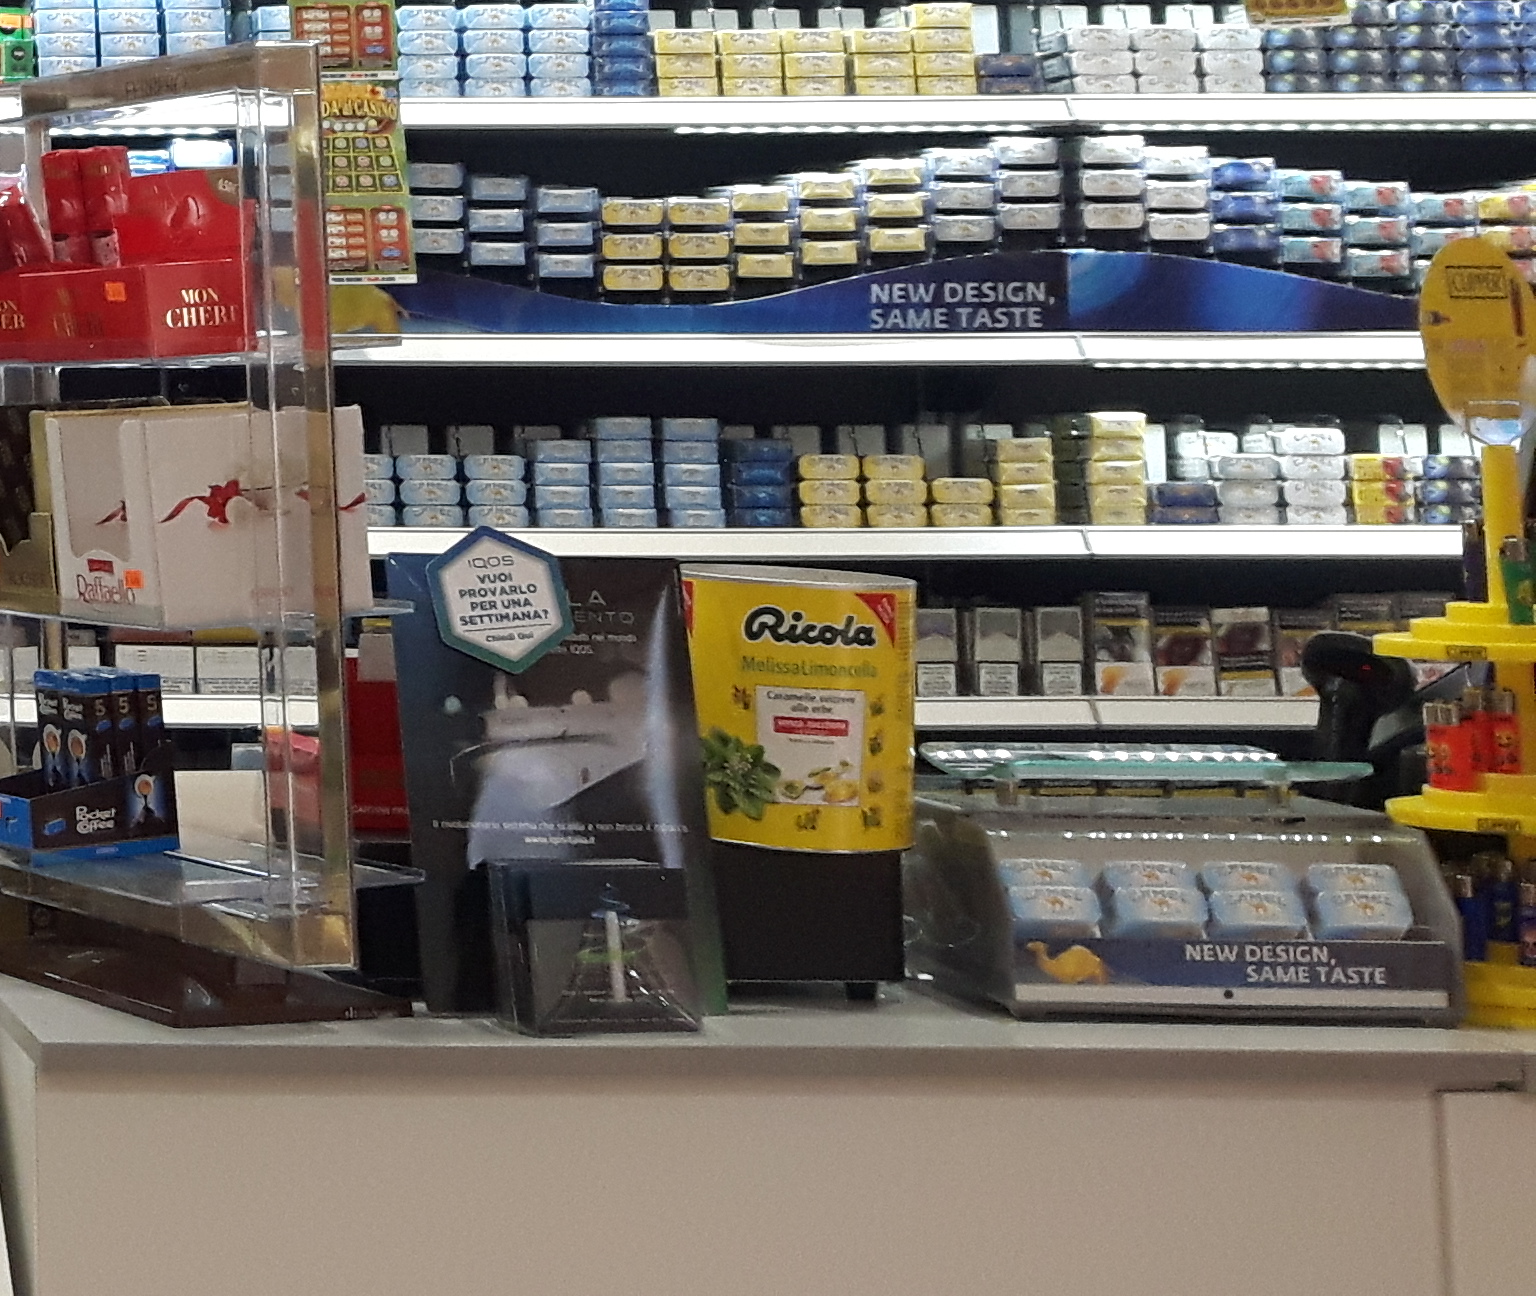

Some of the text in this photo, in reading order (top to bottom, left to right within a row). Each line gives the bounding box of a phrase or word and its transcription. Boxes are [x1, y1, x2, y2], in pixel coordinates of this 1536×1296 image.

[180, 287, 220, 305] MON
[869, 281, 1056, 306] NEW DESIGN,
[869, 307, 1044, 329] SAME TASTE
[467, 555, 514, 569] IQOS
[477, 573, 513, 584] VUOI
[458, 584, 537, 599] PROVARLO
[470, 598, 533, 612] PER UNA
[459, 609, 549, 626] SETTIMANA?
[744, 605, 876, 649] Ricola
[75, 805, 117, 821] Pocket
[75, 818, 115, 834] Coffee
[1184, 944, 1336, 968] NEW DESIGN,
[1246, 963, 1387, 985] SAME TASTE
